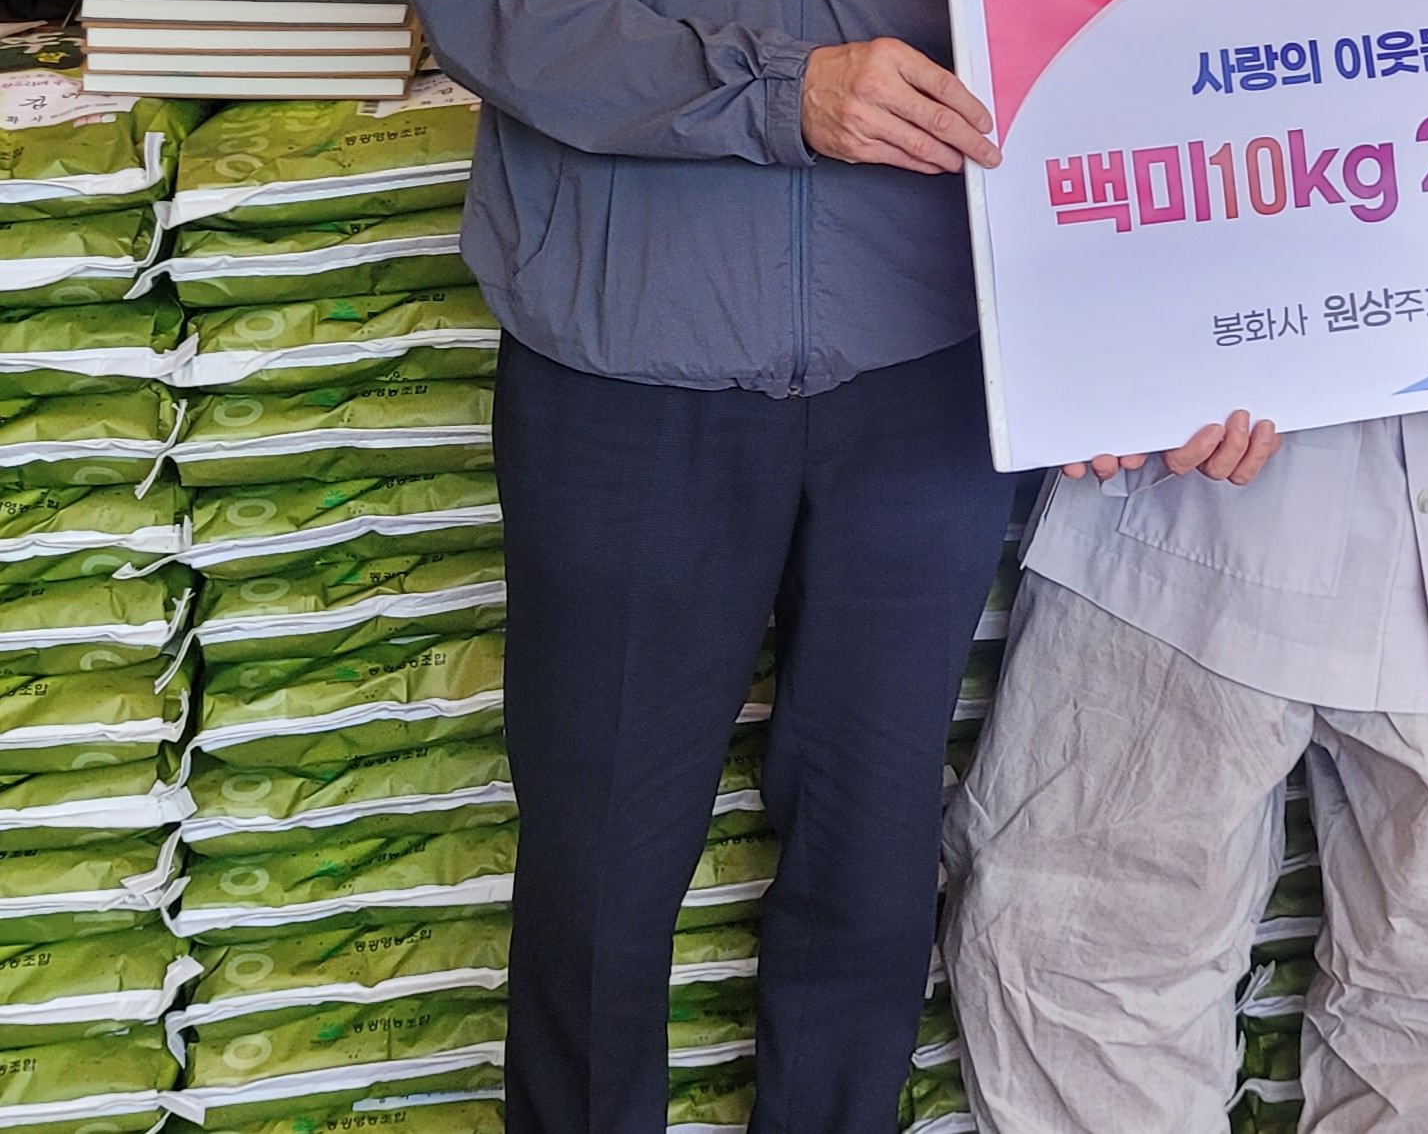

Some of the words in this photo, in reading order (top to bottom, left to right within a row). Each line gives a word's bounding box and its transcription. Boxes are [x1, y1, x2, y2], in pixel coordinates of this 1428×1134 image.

[1192, 40, 1322, 95] 사랑의
[1046, 129, 1398, 233] 백미10kg
[1212, 305, 1309, 347] 봉화사
